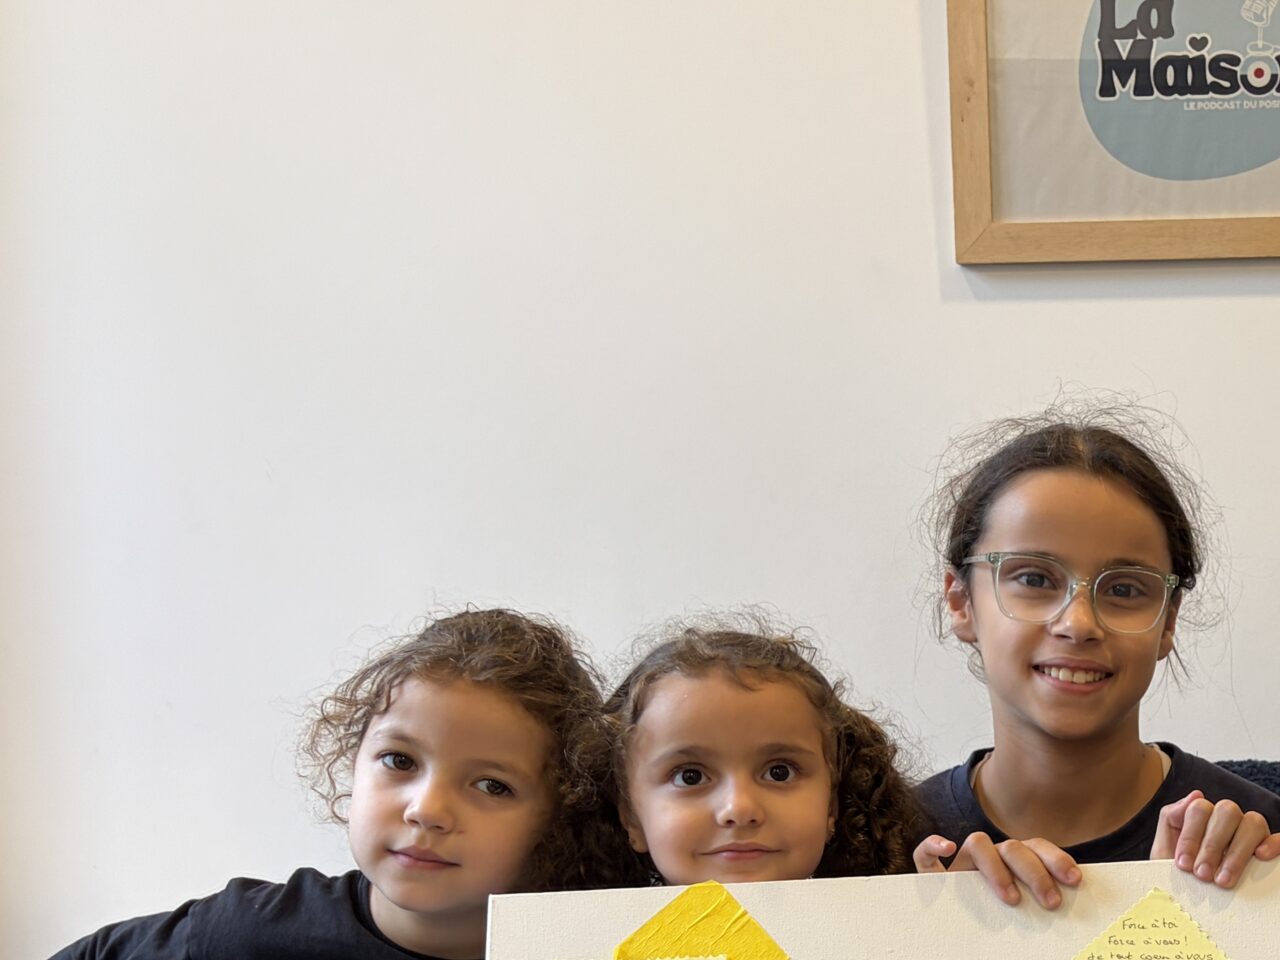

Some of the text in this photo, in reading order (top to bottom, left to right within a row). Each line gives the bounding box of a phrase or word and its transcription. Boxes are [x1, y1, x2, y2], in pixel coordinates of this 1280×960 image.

[1098, 0, 1175, 39] La
[1184, 101, 1195, 111] LE
[1197, 101, 1241, 111] PODCAST
[1243, 100, 1257, 109] DU
[1163, 917, 1179, 928] toi
[1108, 936, 1136, 946] Force
[1110, 952, 1132, 960] tout
[1186, 953, 1214, 960] vous
